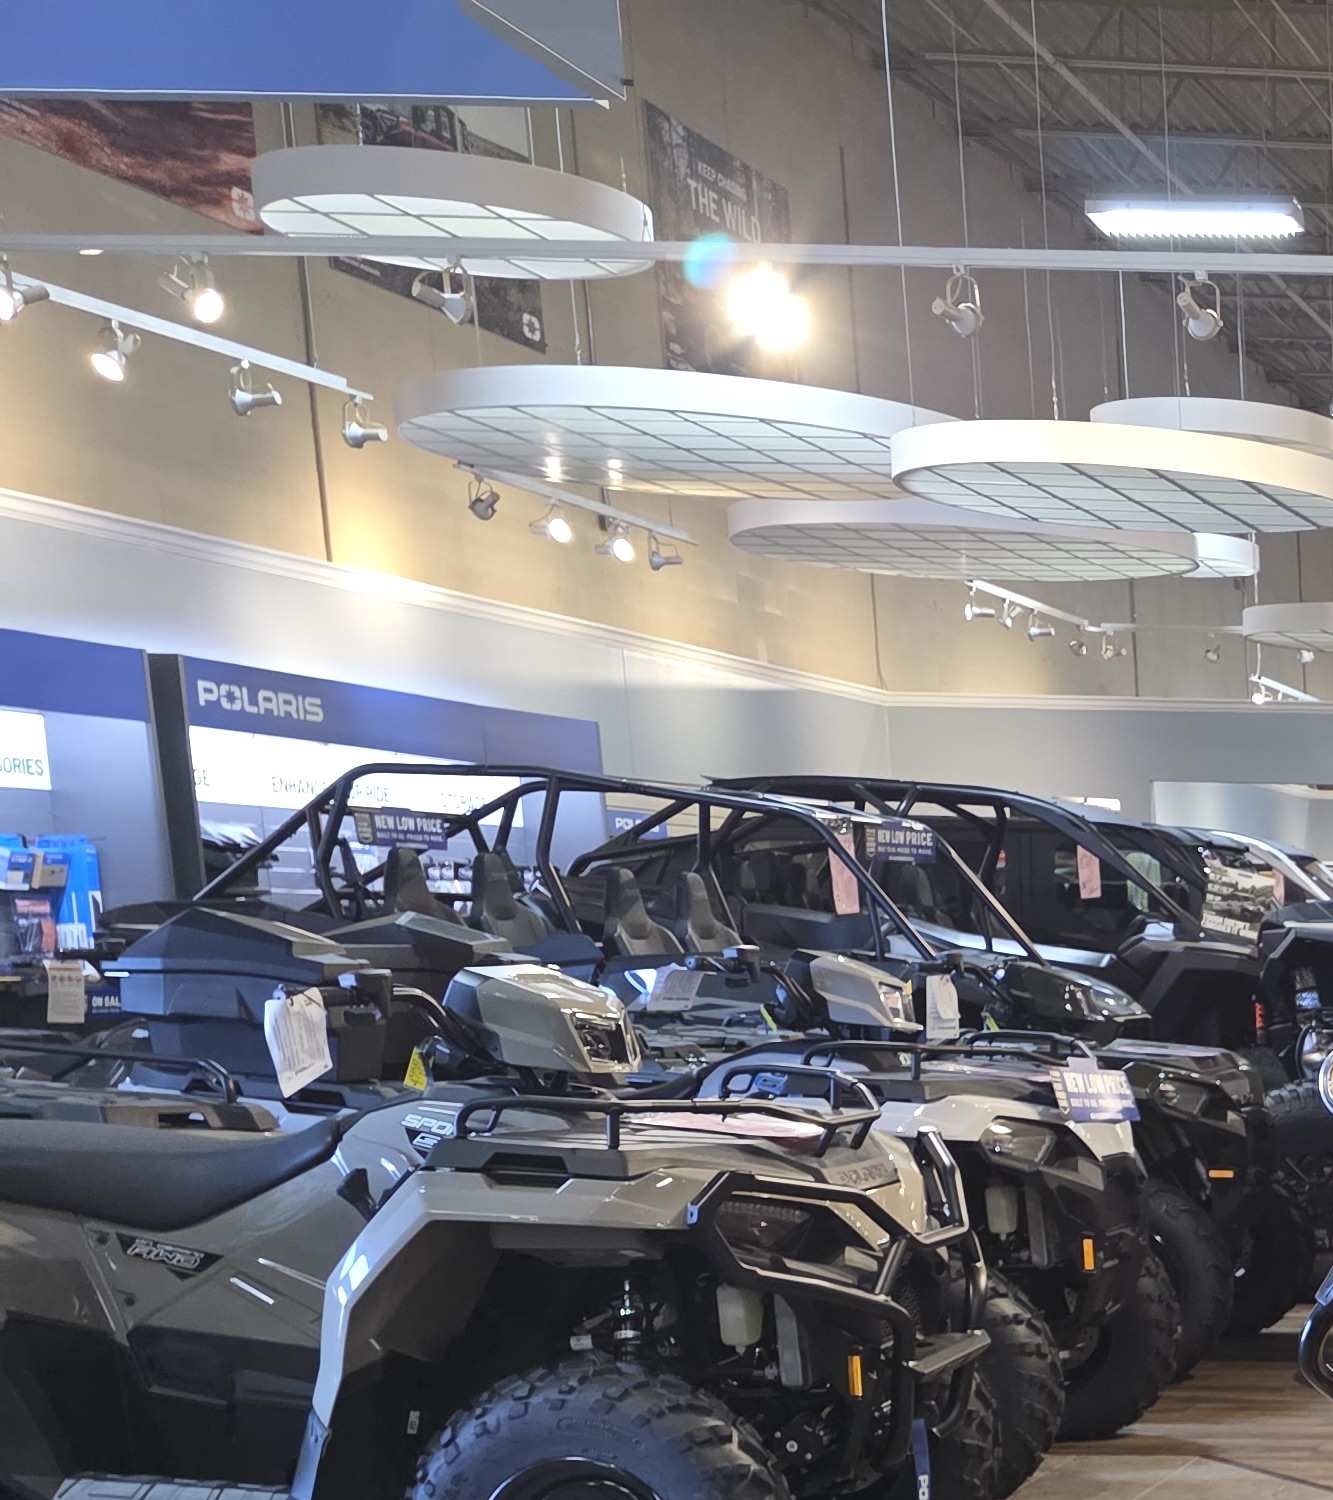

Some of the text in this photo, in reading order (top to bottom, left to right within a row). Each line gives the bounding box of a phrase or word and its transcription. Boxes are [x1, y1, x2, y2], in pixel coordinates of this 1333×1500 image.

[687, 177, 761, 242] THE WILD
[197, 679, 324, 723] POLARIS
[374, 814, 443, 834] NEW LOW PRICE
[877, 829, 933, 847] NEW LOW PRICE
[1063, 1071, 1131, 1095] NEW LOW PRICE
